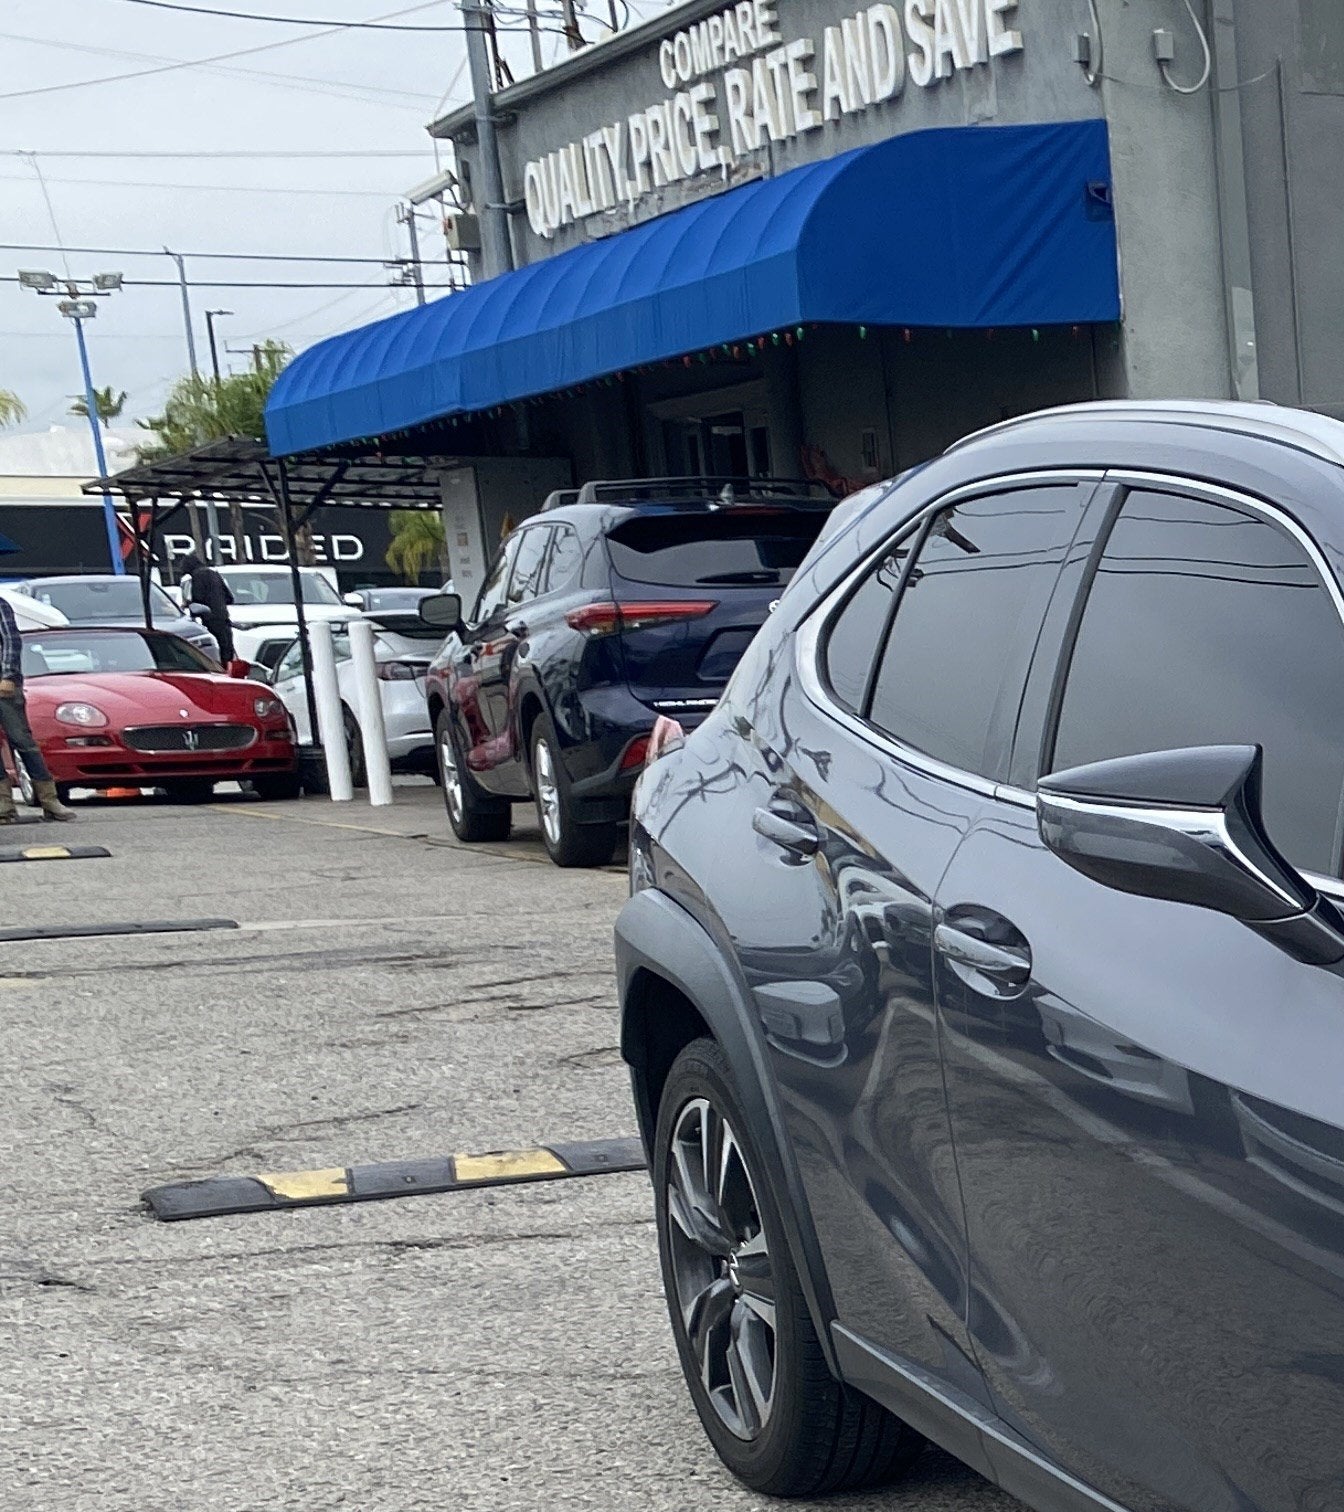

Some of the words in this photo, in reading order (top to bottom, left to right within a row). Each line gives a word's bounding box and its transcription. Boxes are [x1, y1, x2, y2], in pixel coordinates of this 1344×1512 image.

[660, 0, 782, 89] COMPARE
[724, 38, 823, 156] RATE
[824, 4, 904, 121] AND
[905, 0, 1023, 87] SAVE
